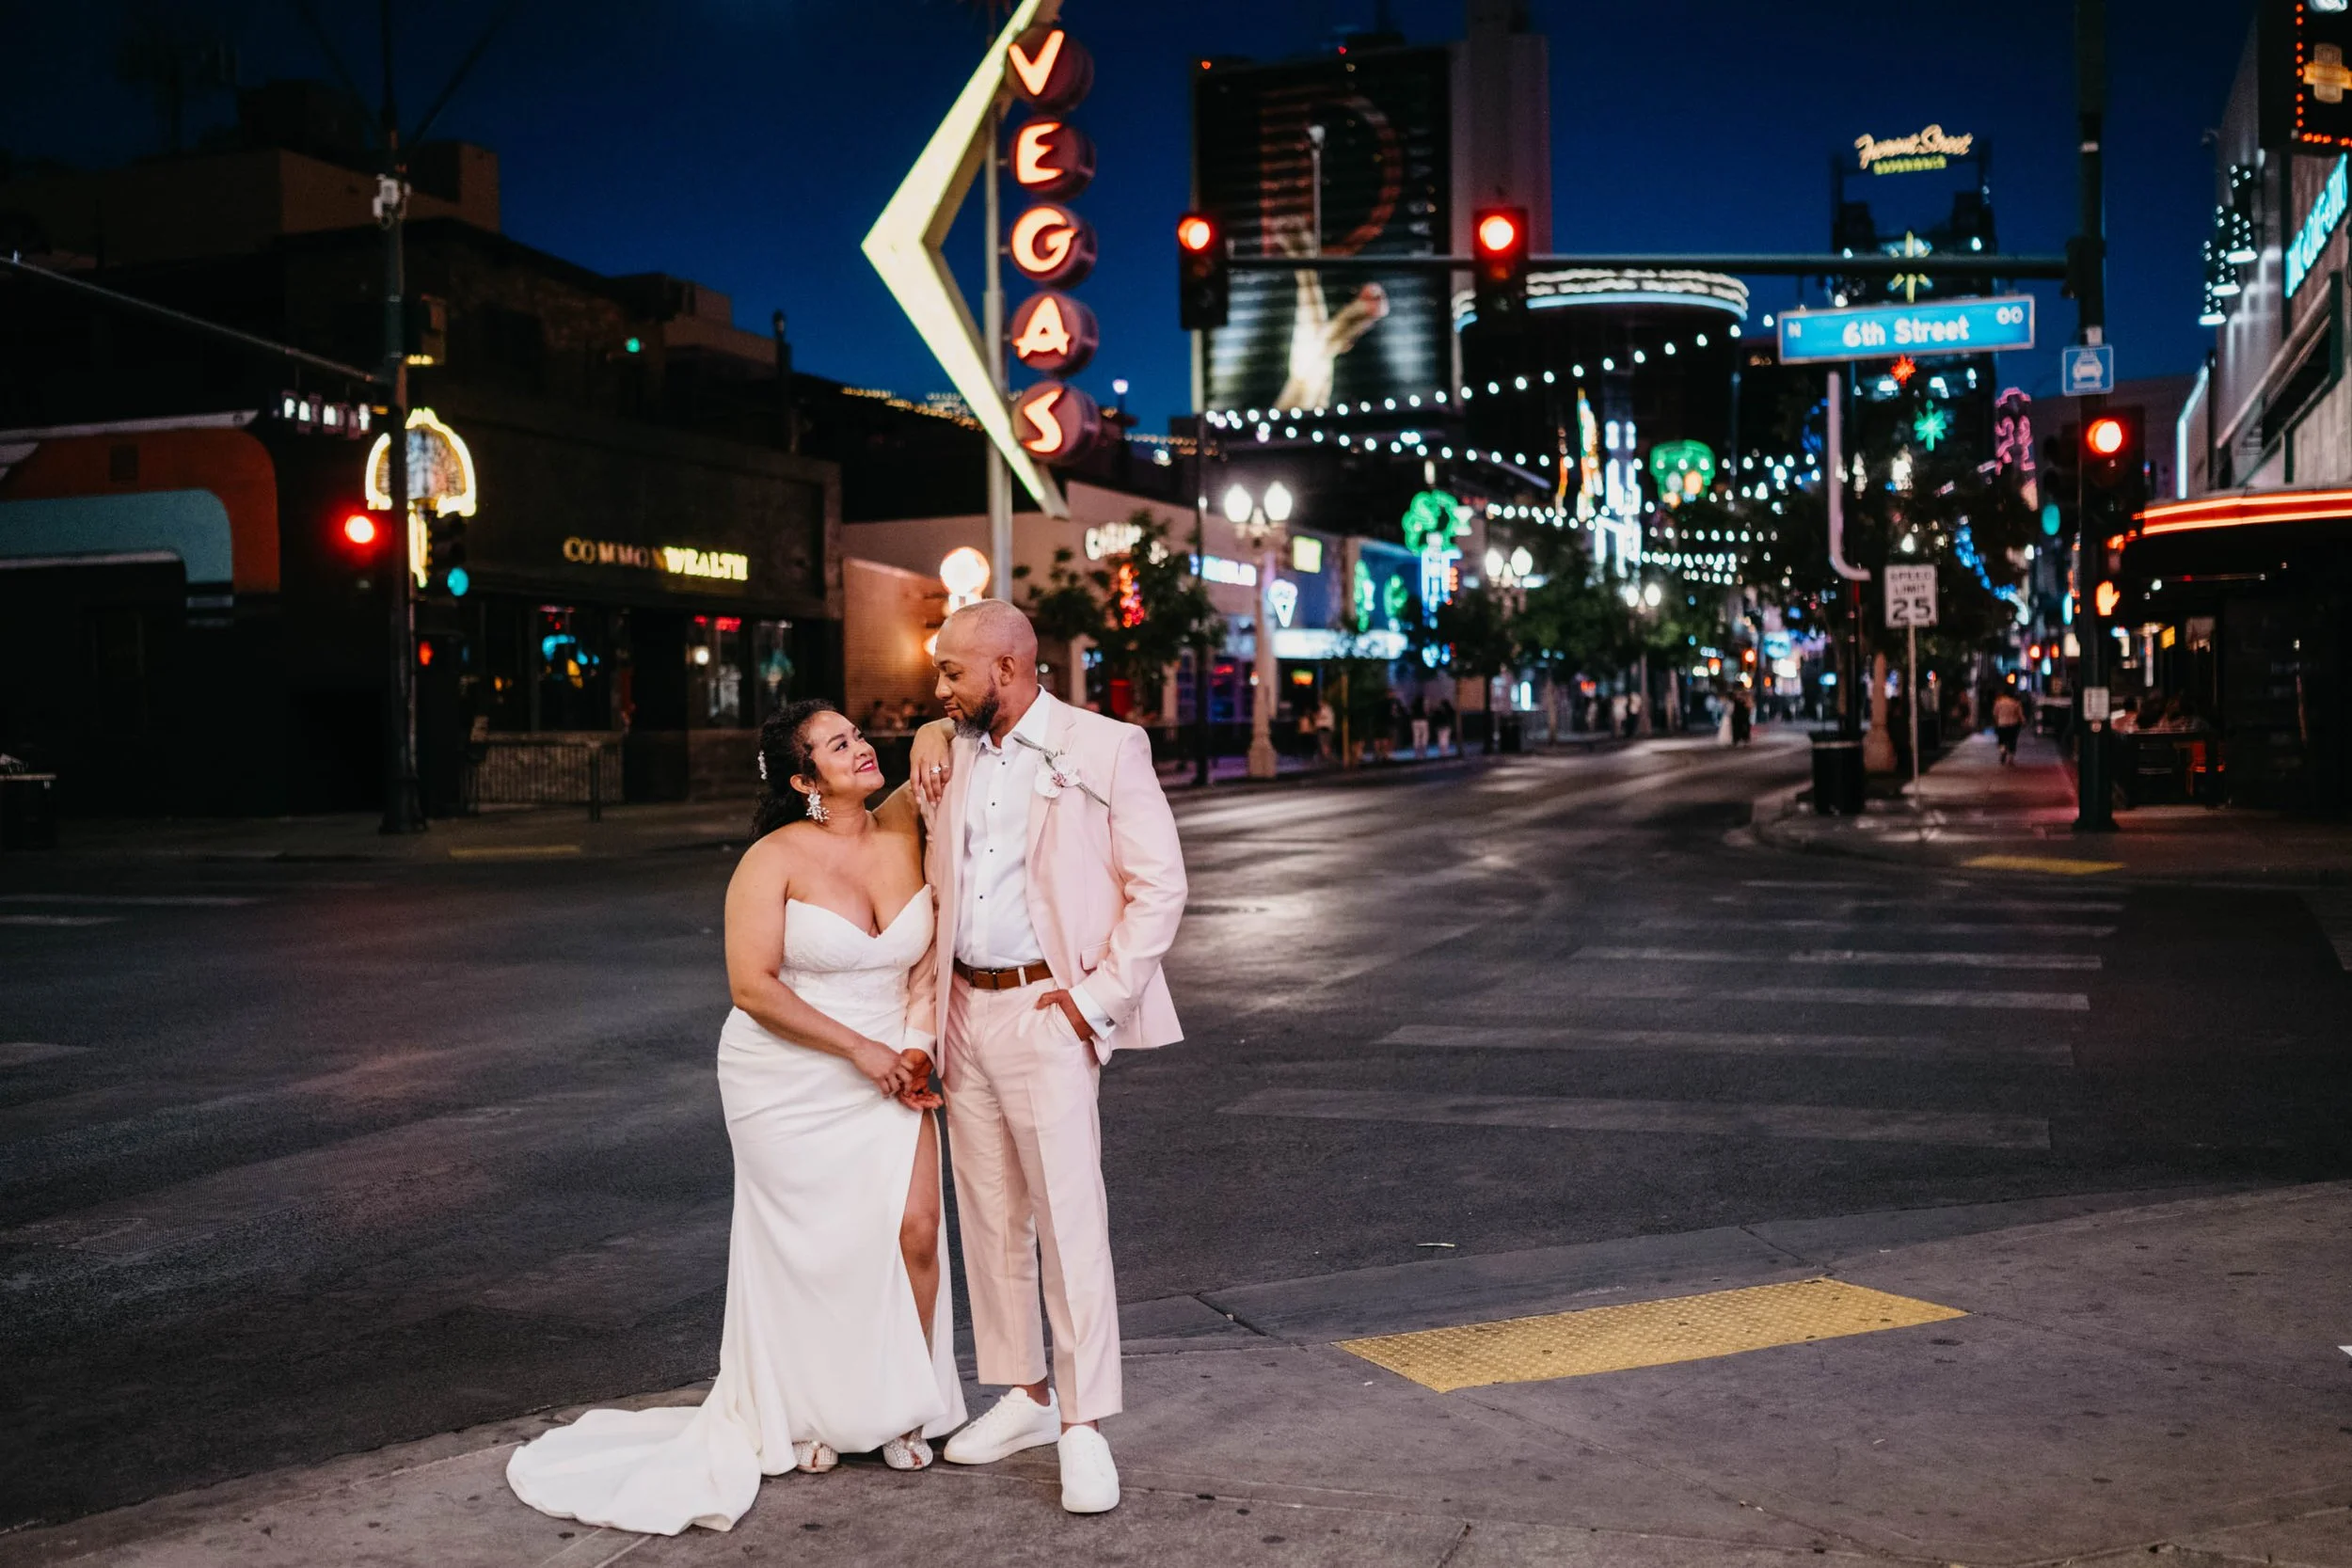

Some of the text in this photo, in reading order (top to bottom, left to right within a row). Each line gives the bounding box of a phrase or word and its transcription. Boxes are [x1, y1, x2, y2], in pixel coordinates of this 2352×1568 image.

[1008, 28, 1077, 453] VEGAS
[1843, 321, 1885, 347] 6th
[1894, 315, 1970, 344] Street
[1890, 571, 1932, 581] SPEED
[1894, 583, 1927, 595] LIMIT
[1893, 596, 1931, 621] 25
